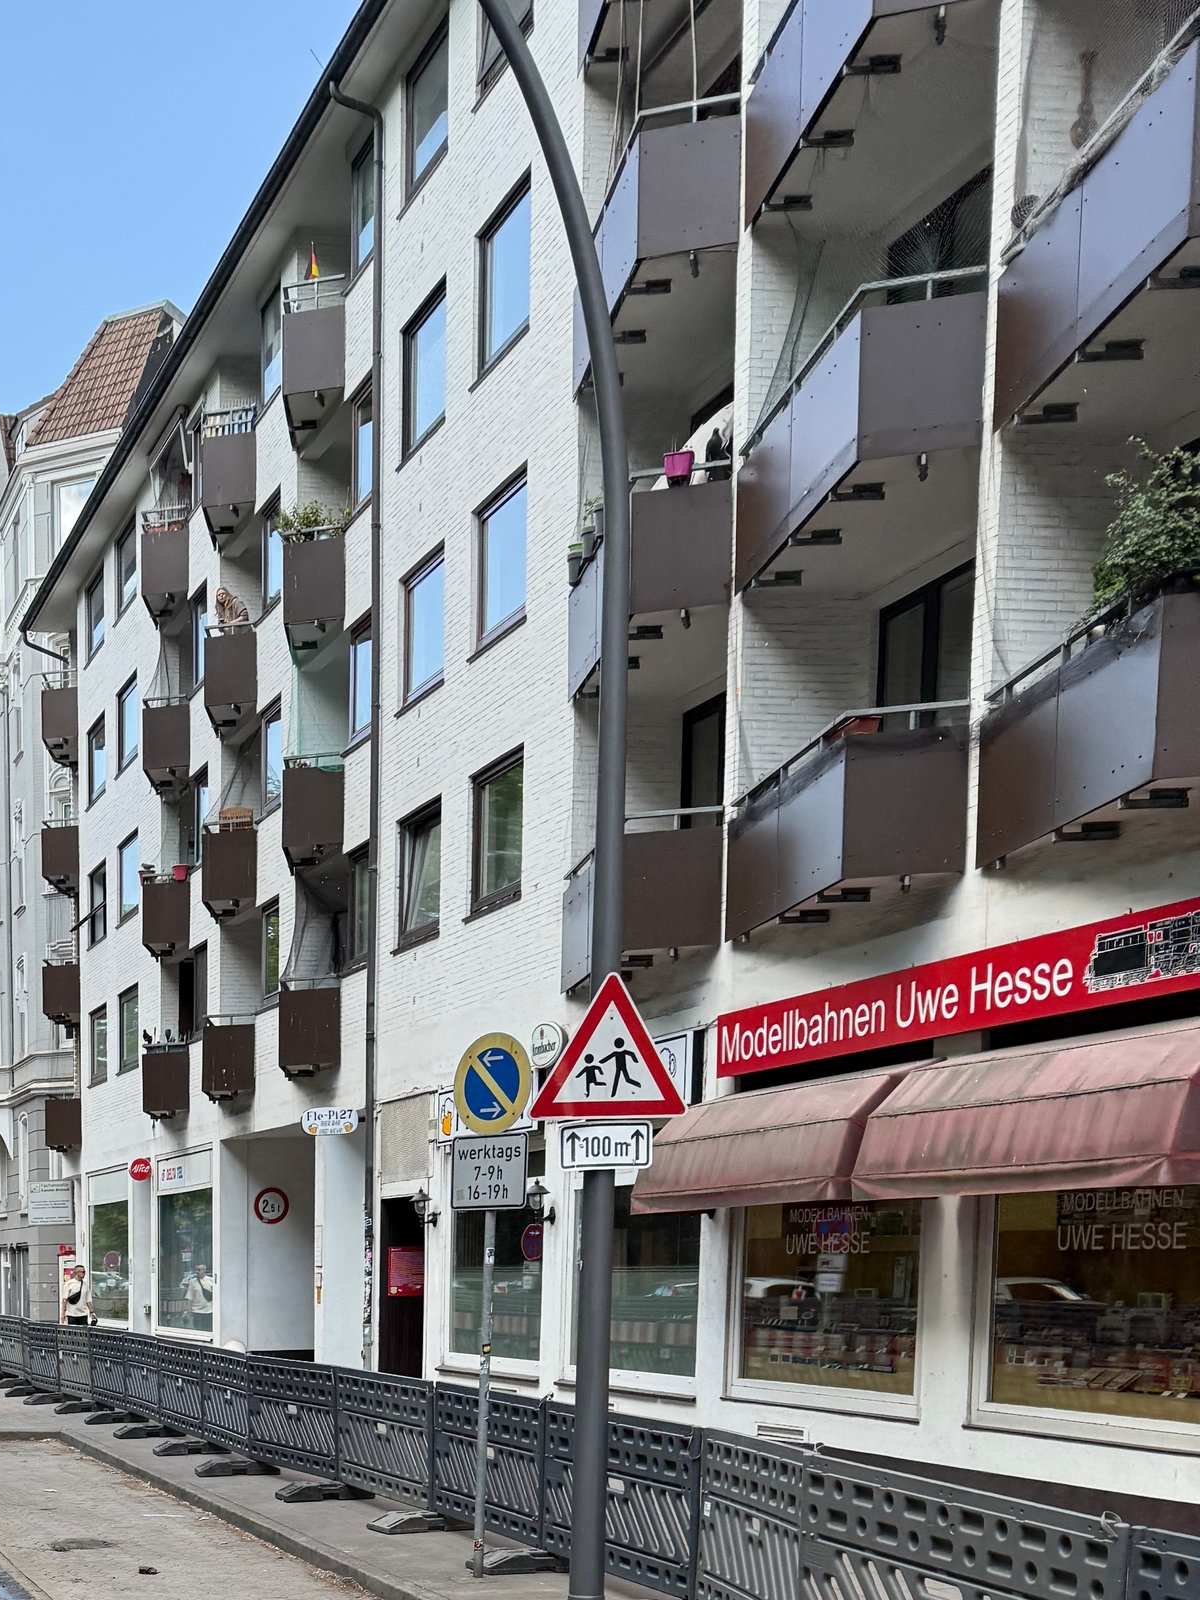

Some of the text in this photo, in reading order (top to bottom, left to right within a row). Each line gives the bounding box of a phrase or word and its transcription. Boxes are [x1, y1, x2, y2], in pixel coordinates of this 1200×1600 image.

[721, 958, 1073, 1065] Modellbahnen Uwe Hesse
[458, 1144, 521, 1162] werktags
[582, 1136, 631, 1157] 100 m
[1063, 1189, 1184, 1211] MODELLBAHNEN
[790, 1205, 869, 1222] MODELLBAHNEN
[786, 1231, 870, 1255] UWE HESSE
[1058, 1222, 1188, 1251] UWE HESSE
